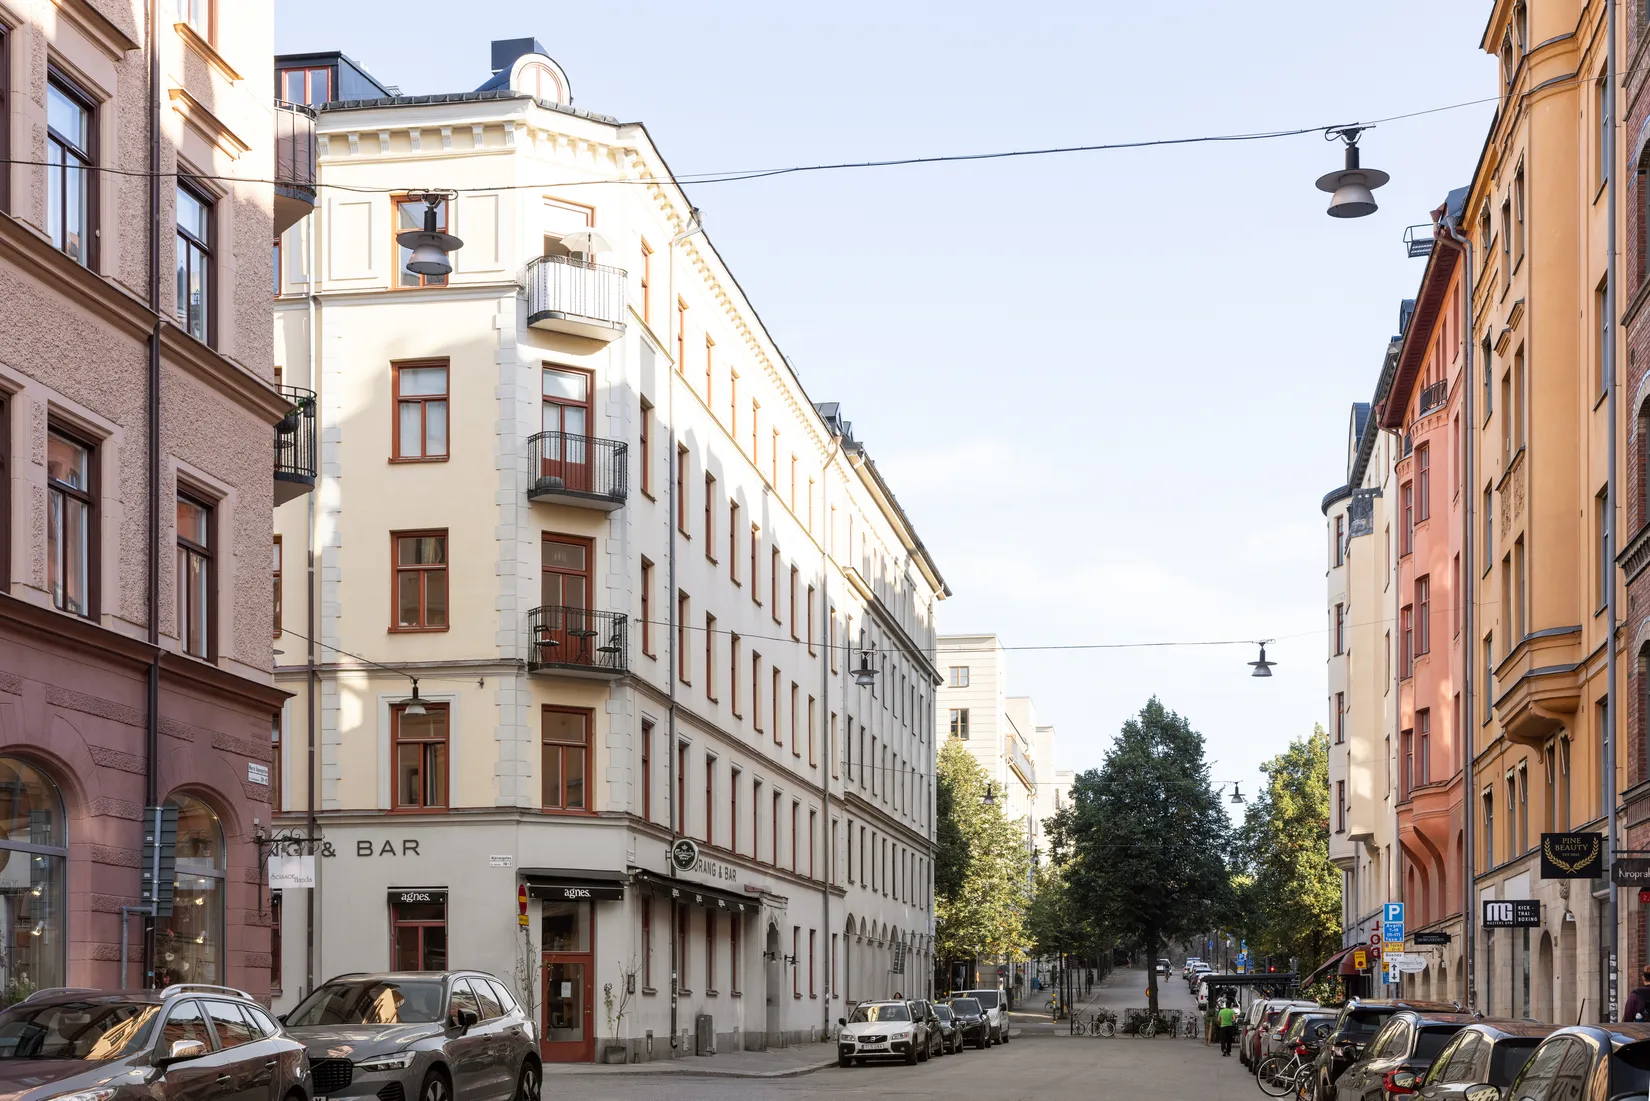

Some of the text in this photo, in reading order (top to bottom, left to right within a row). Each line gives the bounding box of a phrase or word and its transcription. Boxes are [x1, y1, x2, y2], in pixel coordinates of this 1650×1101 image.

[321, 841, 337, 857] &
[356, 839, 421, 857] BAR
[724, 866, 737, 883] BAR
[401, 892, 431, 903] agnes.
[564, 887, 592, 899] agnes.
[1388, 905, 1400, 920] P
[1486, 902, 1513, 922] MG
